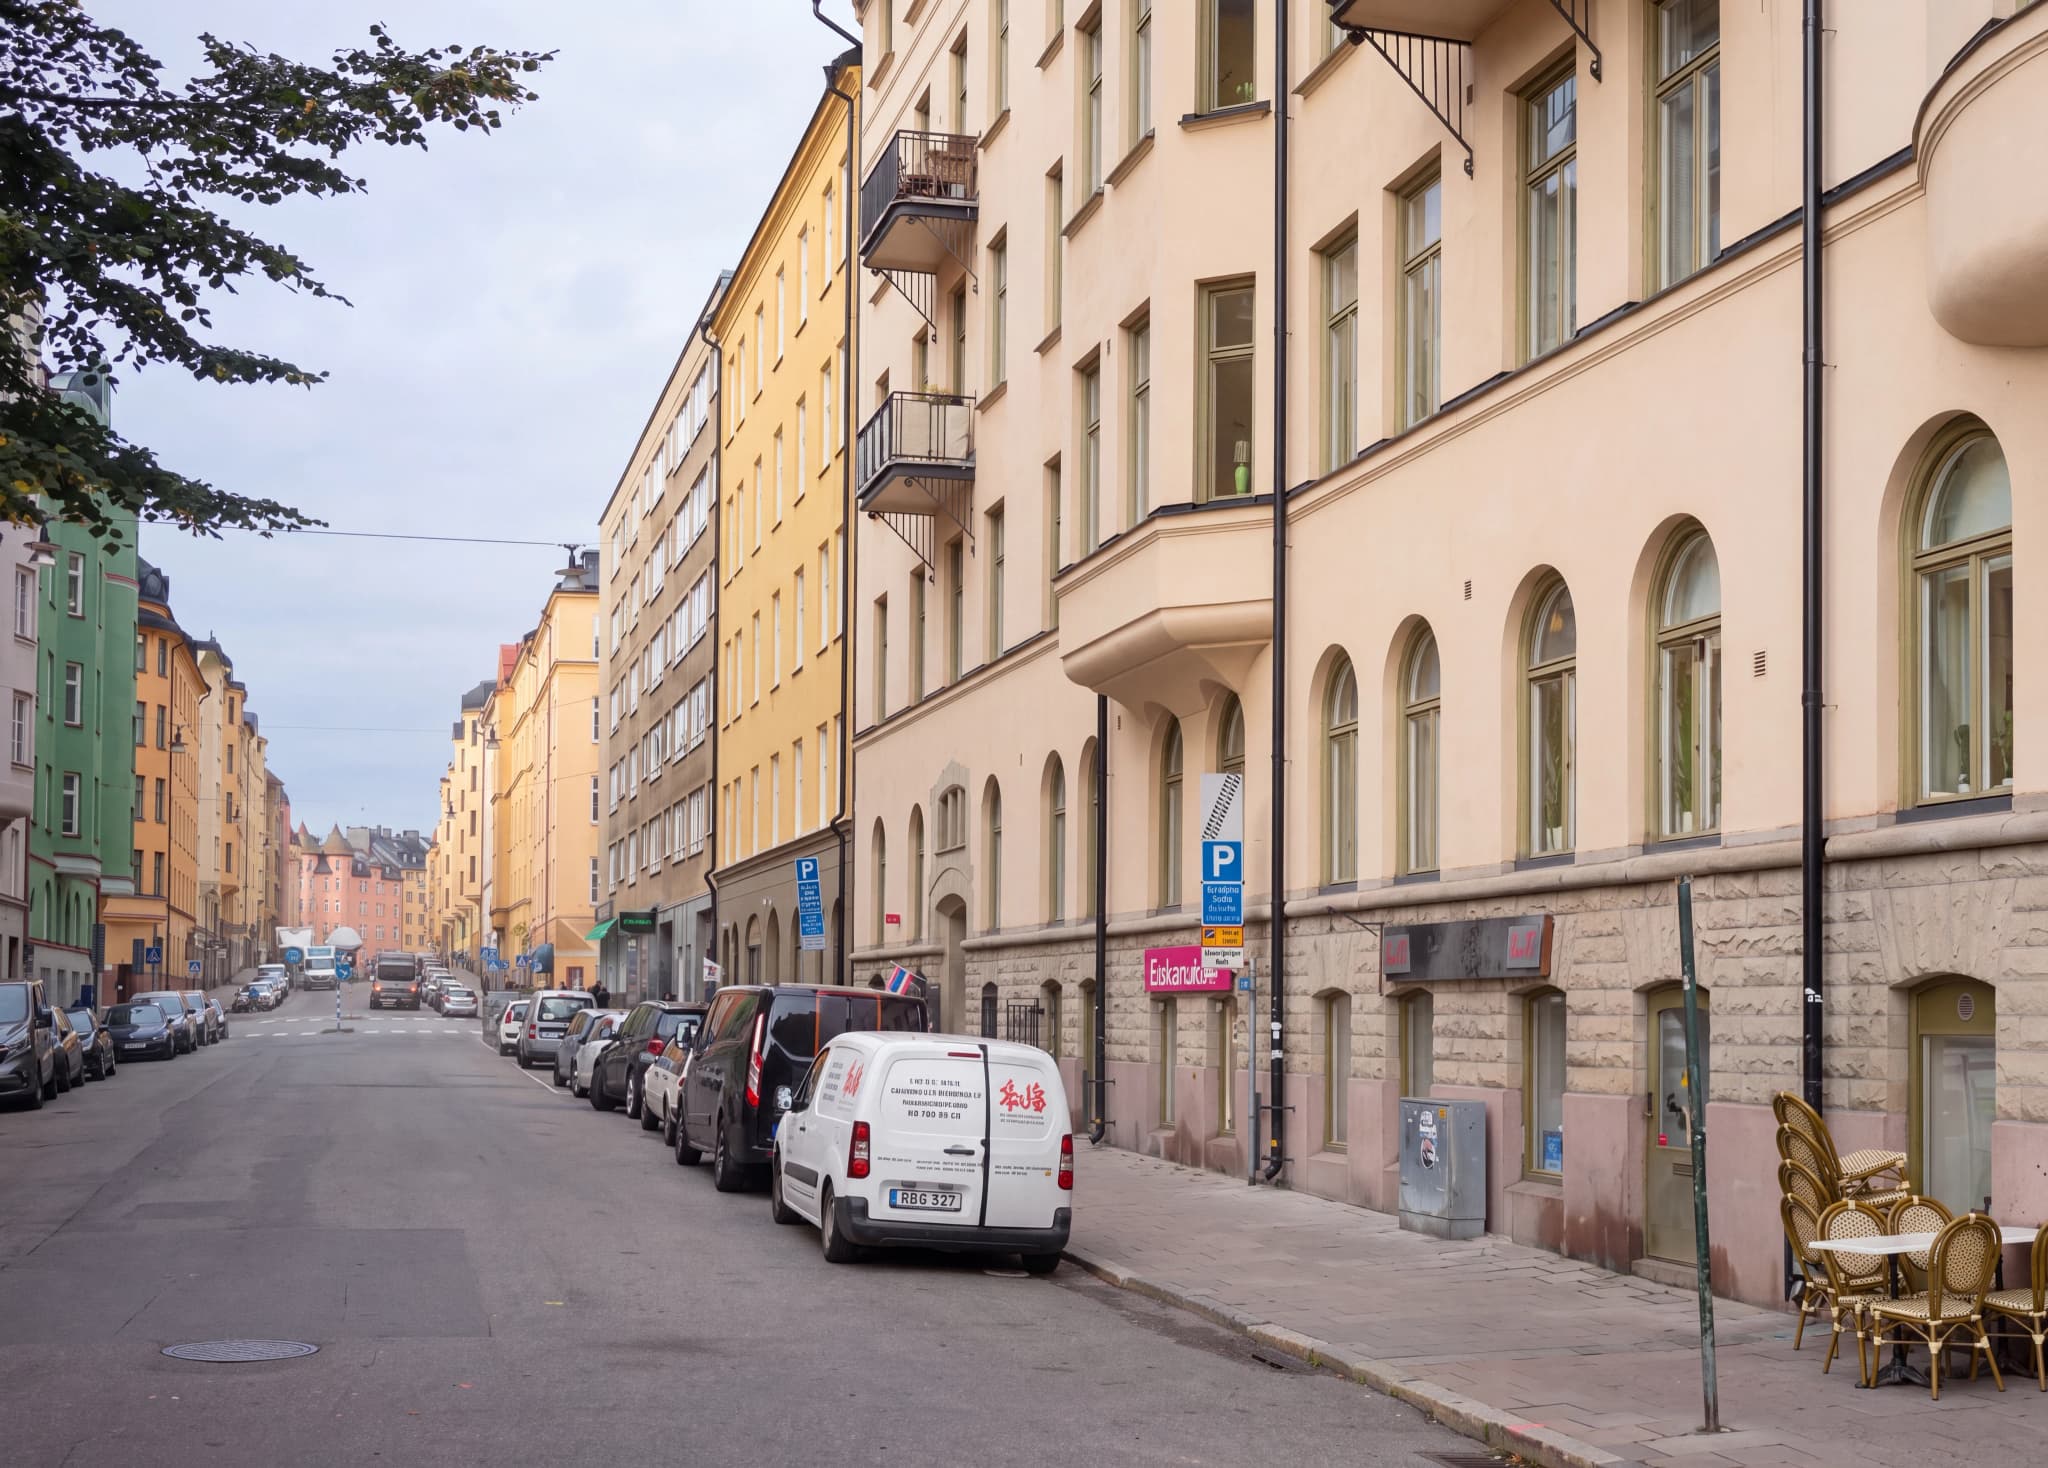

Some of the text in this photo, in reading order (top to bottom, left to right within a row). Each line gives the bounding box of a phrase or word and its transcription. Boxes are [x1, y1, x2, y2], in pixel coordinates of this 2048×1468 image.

[801, 861, 814, 879] P
[1213, 845, 1235, 877] P
[901, 1192, 956, 1207] RBG 327
